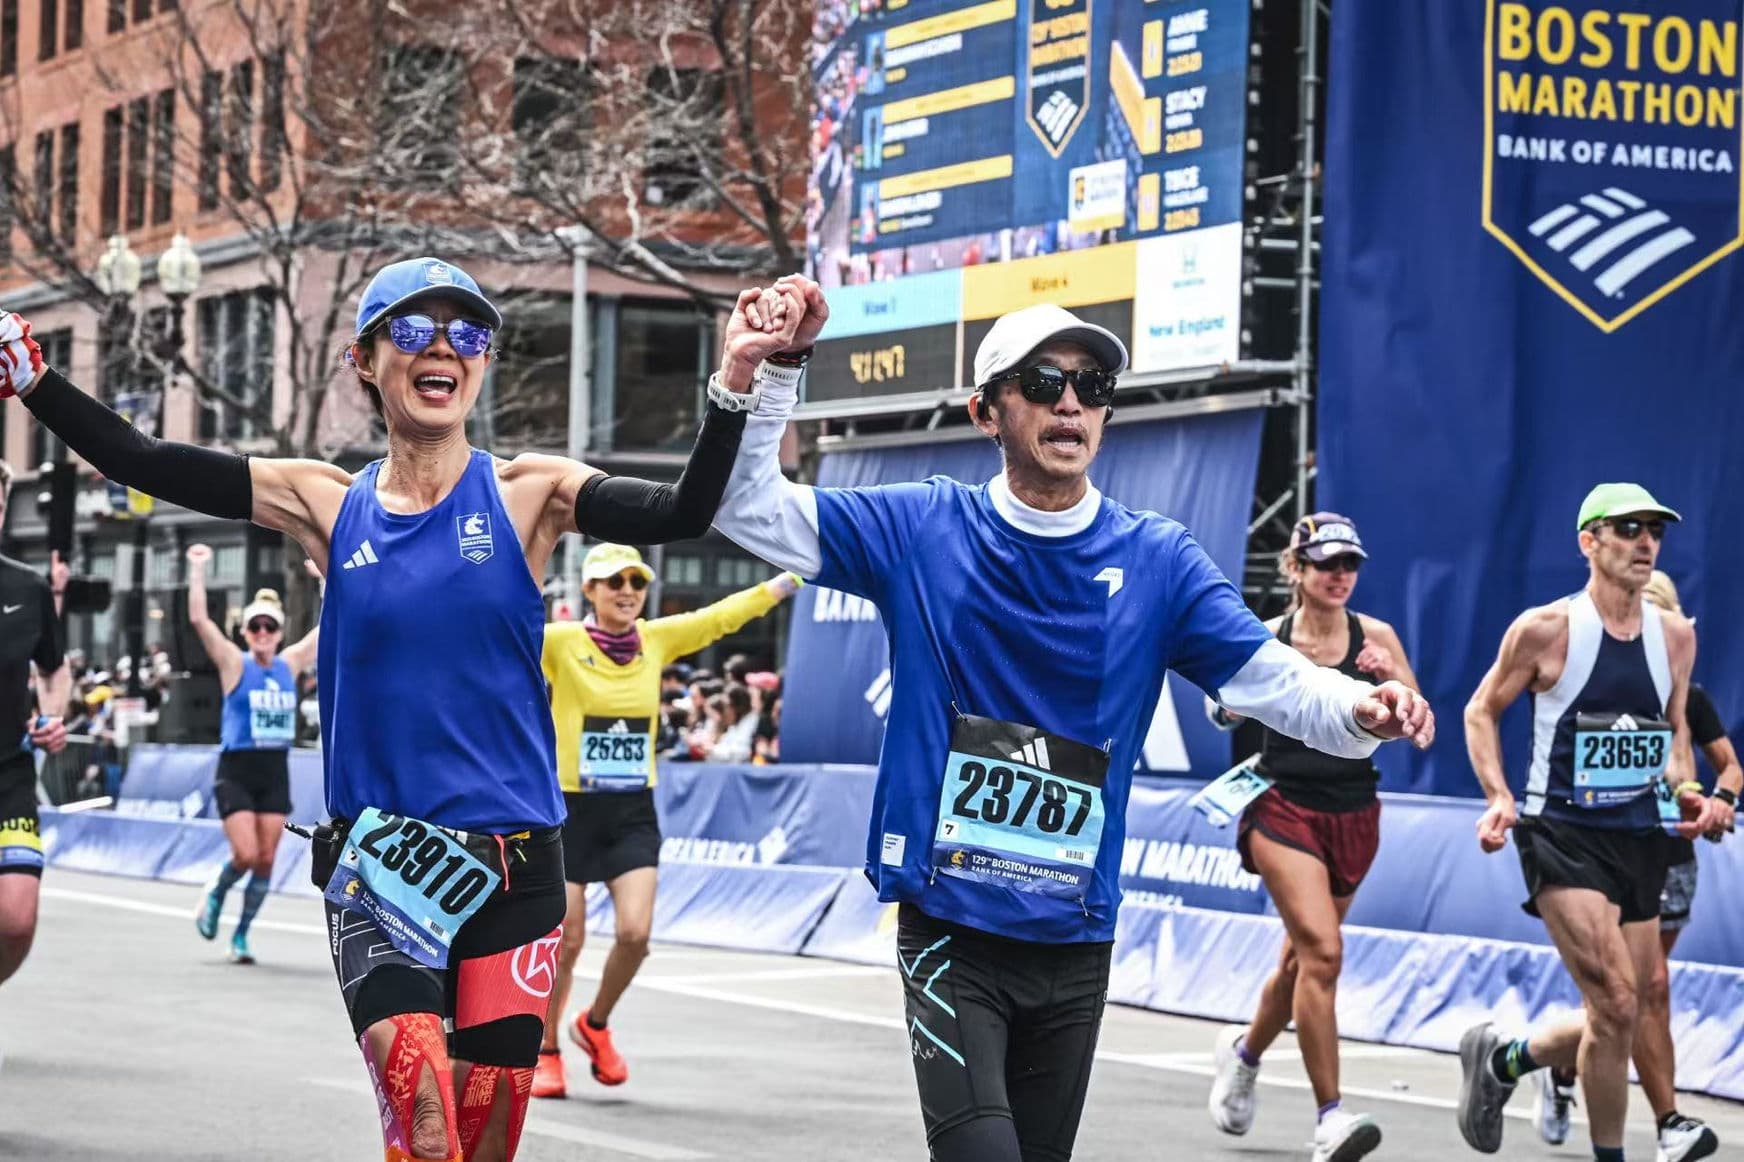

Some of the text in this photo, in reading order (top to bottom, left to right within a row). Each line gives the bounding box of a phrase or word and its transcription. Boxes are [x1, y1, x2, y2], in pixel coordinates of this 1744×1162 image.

[1498, 2, 1737, 77] BOSTON
[1498, 70, 1736, 129] MARATHON
[1497, 134, 1734, 173] BANK OF AMERICA
[1178, 315, 1225, 336] England
[586, 736, 645, 761] 25263
[1583, 735, 1664, 769] 23653
[952, 761, 1093, 837] 23787
[944, 823, 955, 836] 7
[358, 811, 489, 915] 23910
[971, 866, 1033, 883] BANK OF AMERICA
[991, 858, 1029, 874] BOSTON
[1029, 865, 1080, 885] MARATHON
[331, 912, 340, 956] FOCUS
[374, 905, 439, 958] BOSTON MARATHON
